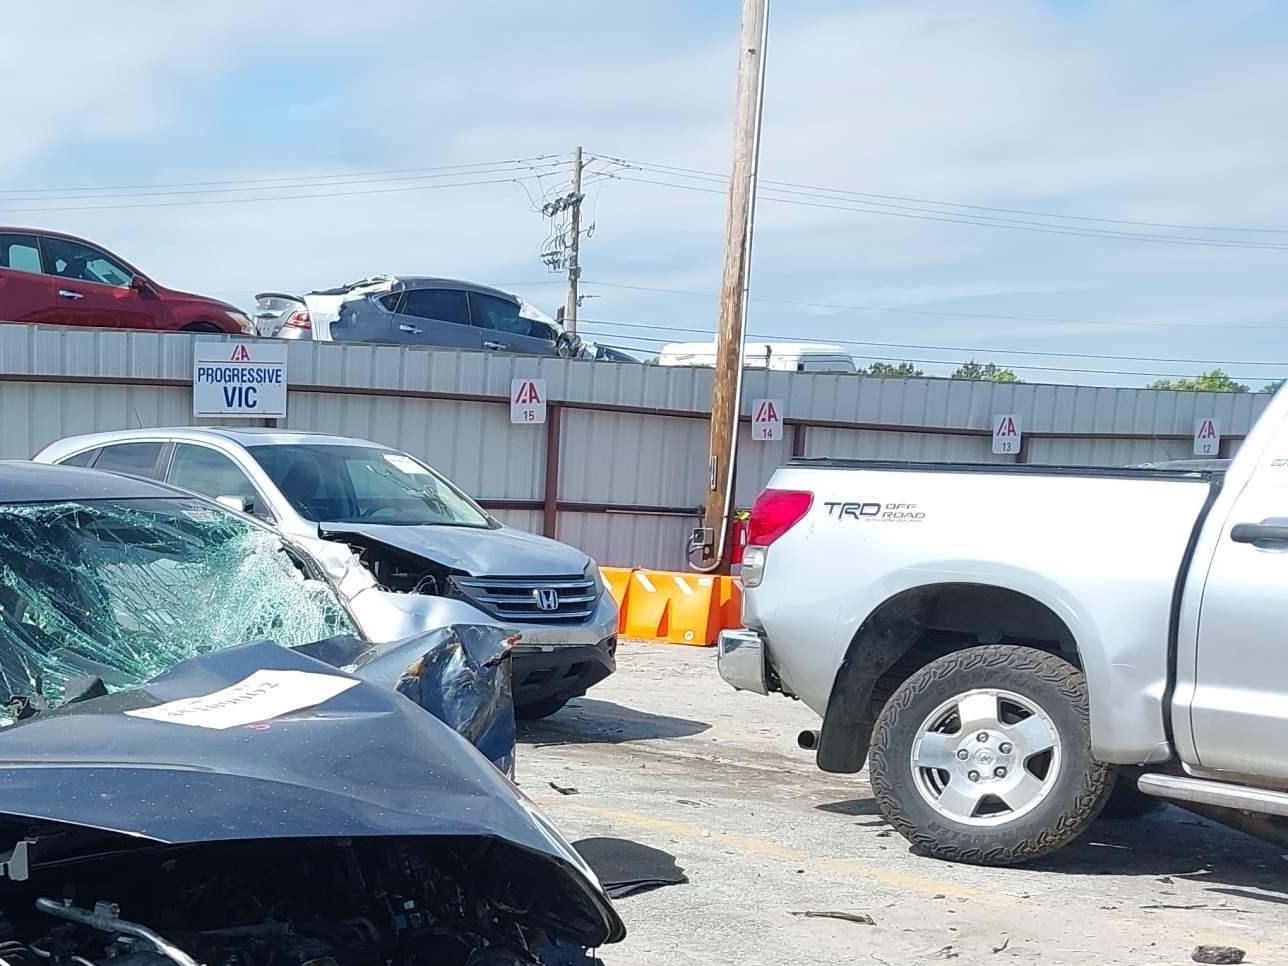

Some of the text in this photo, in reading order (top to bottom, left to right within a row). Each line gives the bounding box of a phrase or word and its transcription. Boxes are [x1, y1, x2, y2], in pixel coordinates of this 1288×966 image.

[197, 367, 282, 384] PROGRESSIVE
[223, 386, 258, 409] VIC
[522, 410, 535, 421] 15
[762, 428, 773, 439] 14
[823, 501, 882, 520] TRD
[882, 511, 926, 519] ROAD
